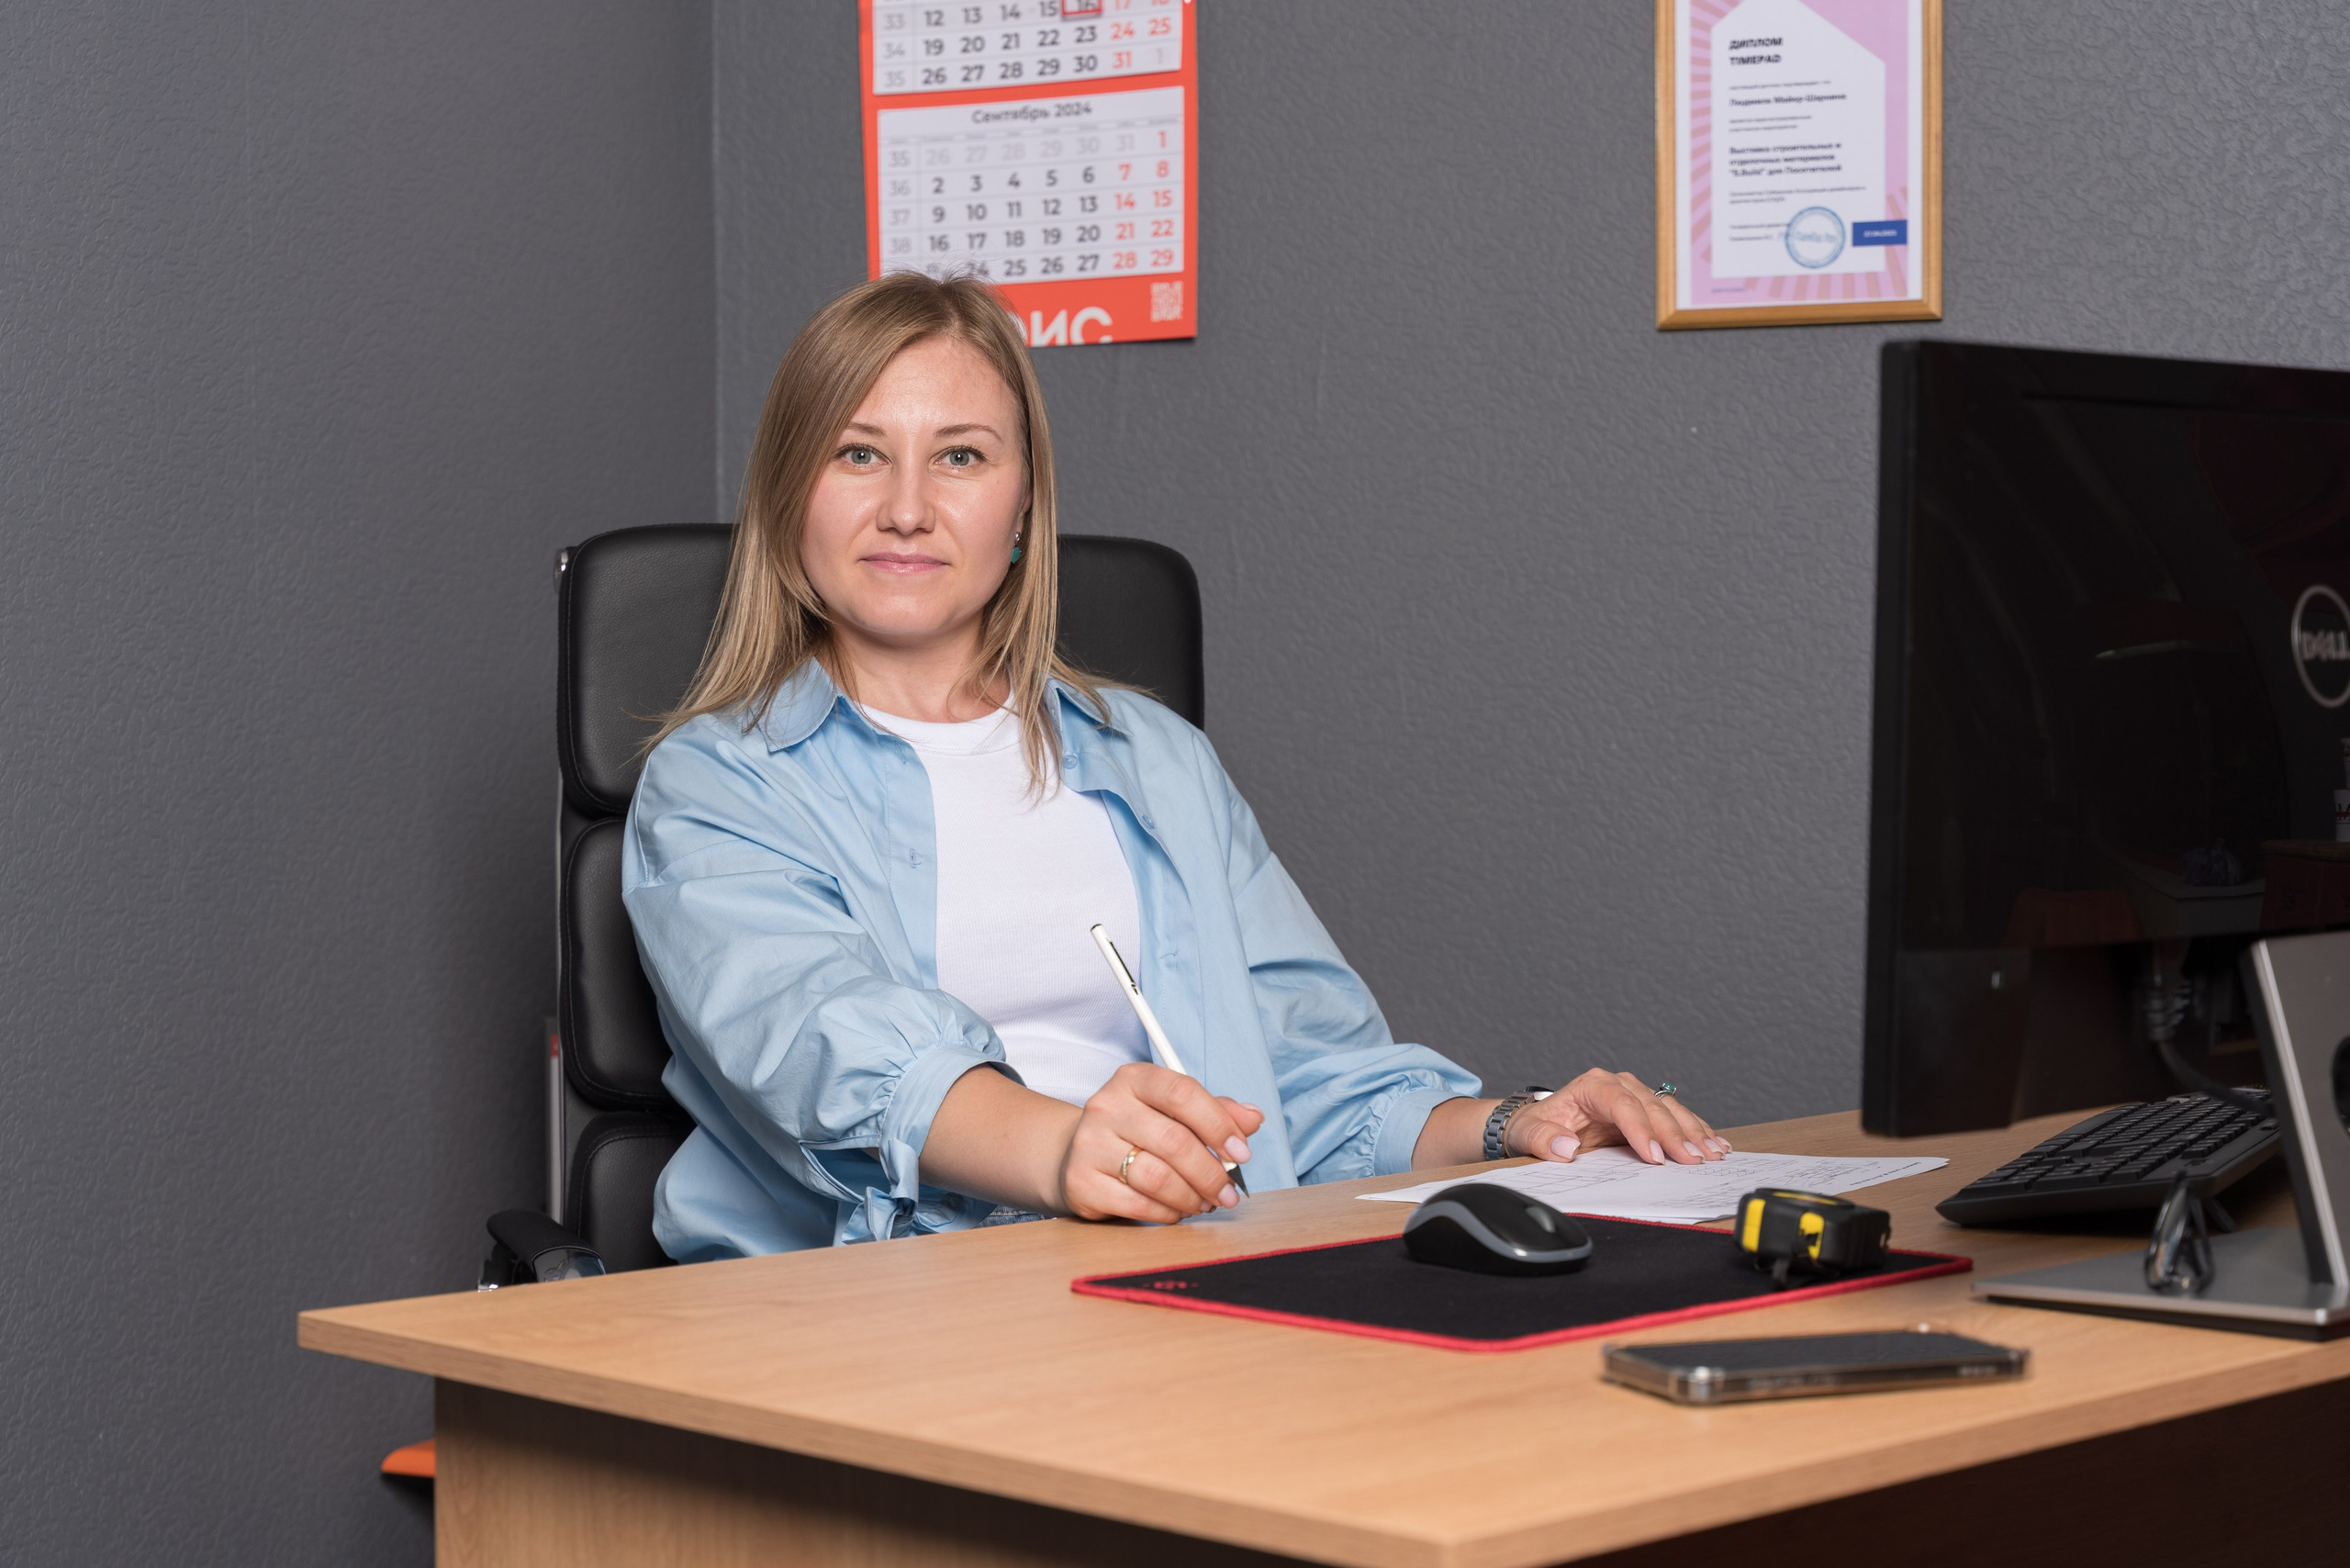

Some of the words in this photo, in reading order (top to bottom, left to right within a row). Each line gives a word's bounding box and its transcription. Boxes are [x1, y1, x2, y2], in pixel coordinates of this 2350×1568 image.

[924, 9, 944, 27] 12
[963, 6, 982, 24] 13
[1001, 5, 1021, 20] 14
[1040, 0, 1058, 18] 15
[923, 39, 945, 56] 19
[960, 36, 985, 53] 20
[1002, 32, 1020, 50] 21
[1038, 29, 1059, 47] 22
[1075, 25, 1097, 43] 23
[1112, 23, 1135, 39] 24
[1148, 17, 1171, 36] 25
[1729, 37, 1784, 50] ДИПЛОМ
[923, 67, 946, 85] 26
[961, 64, 984, 83] 27
[1000, 62, 1024, 80] 28
[1037, 58, 1060, 76] 29
[1074, 55, 1098, 73] 30
[1113, 50, 1132, 69] 31
[971, 106, 1048, 124] Сентябрь
[1054, 102, 1092, 118] 2024
[1158, 130, 1167, 148] 1
[933, 177, 945, 194] 2
[971, 174, 982, 192] 3
[1008, 172, 1022, 189] 4
[1046, 169, 1058, 186] 5
[1082, 166, 1095, 184] 6
[1118, 162, 1132, 181] 7
[1157, 160, 1169, 178] 8
[933, 206, 946, 223] 9
[967, 203, 988, 220] 10
[1007, 201, 1022, 218] 11
[1043, 198, 1061, 216] 12
[1080, 196, 1098, 213] 13
[1115, 194, 1136, 209] 14
[1153, 189, 1172, 207] 15
[929, 234, 949, 252] 16
[968, 232, 987, 249] 17
[1005, 230, 1025, 247] 18
[1042, 228, 1062, 245] 19
[1077, 224, 1101, 243] 20
[1116, 222, 1135, 241] 21
[1151, 218, 1173, 237] 22
[1004, 259, 1026, 277] 25
[1041, 256, 1064, 274] 26
[1078, 253, 1100, 272] 27
[1113, 252, 1137, 269] 28
[1151, 249, 1174, 267] 29
